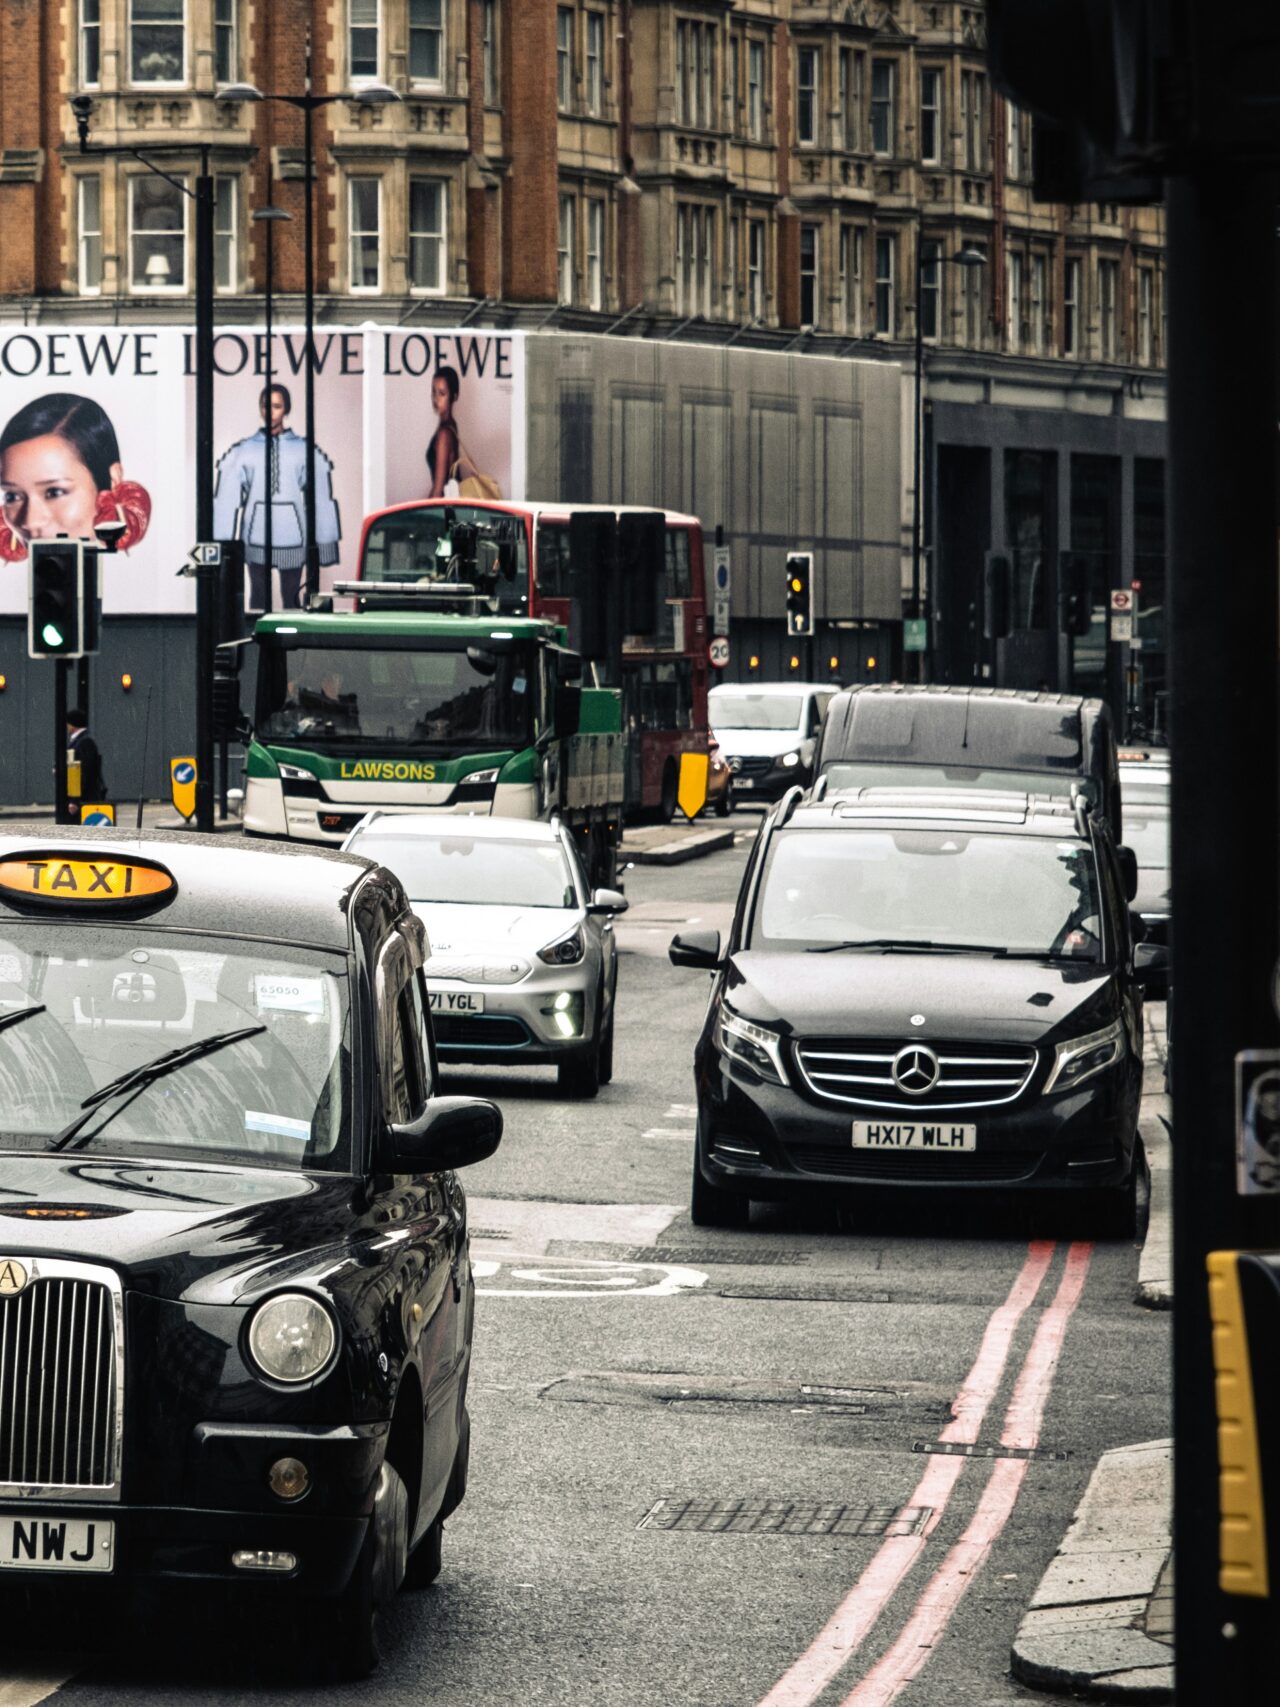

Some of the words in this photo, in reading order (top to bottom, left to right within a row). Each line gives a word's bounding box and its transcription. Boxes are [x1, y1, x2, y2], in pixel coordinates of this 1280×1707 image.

[183, 333, 364, 377] LOEWE
[384, 333, 513, 379] LOEWE
[205, 547, 217, 561] P
[711, 645, 729, 660] 20
[340, 762, 436, 781] LAWSONS
[27, 862, 132, 893] TAXI
[428, 993, 442, 1009] 71
[447, 994, 477, 1010] YGL
[867, 1125, 916, 1145] HX17
[922, 1127, 964, 1147] WLH
[12, 1520, 95, 1562] NWJ
